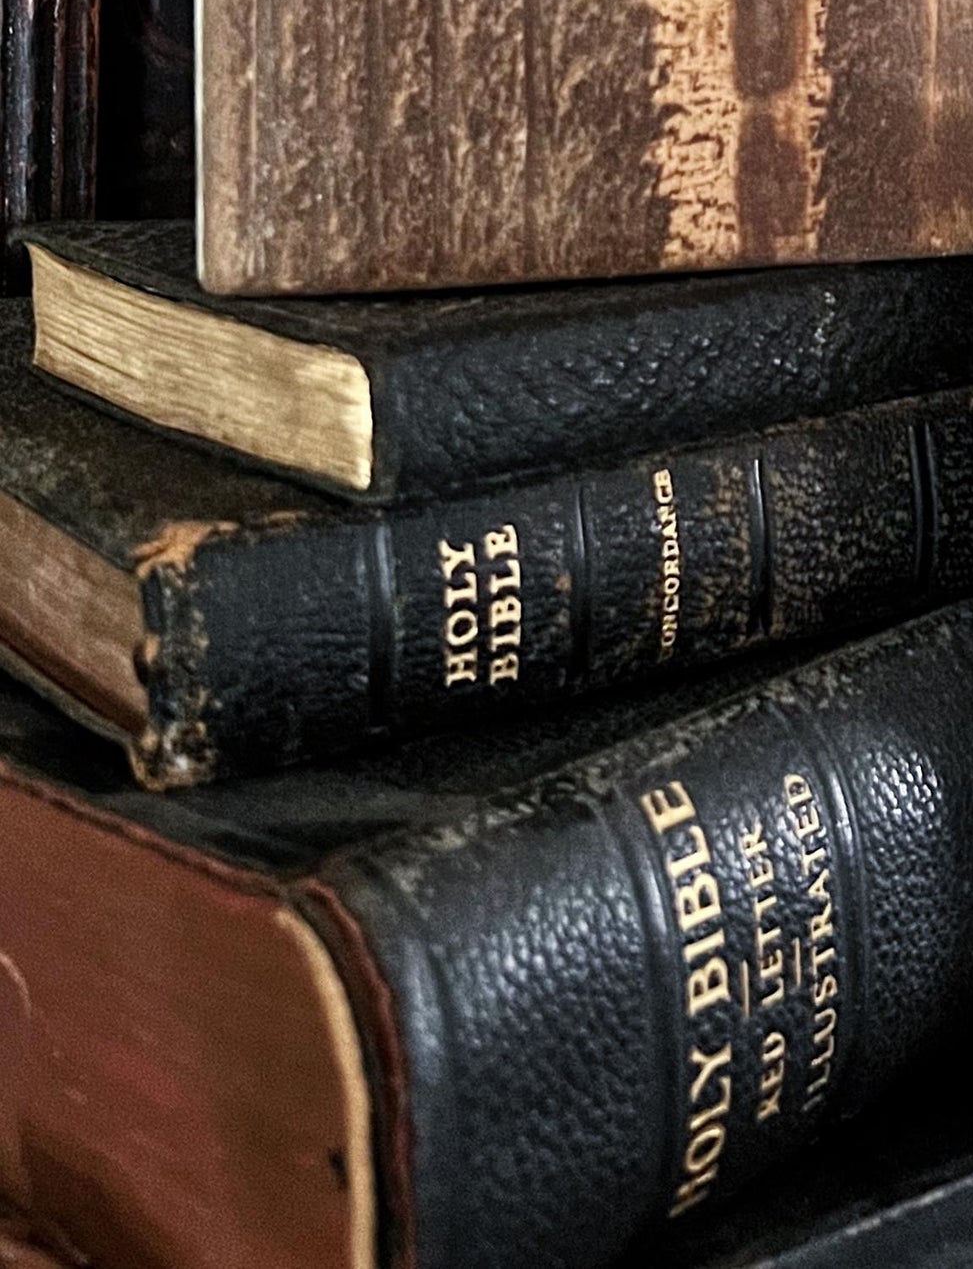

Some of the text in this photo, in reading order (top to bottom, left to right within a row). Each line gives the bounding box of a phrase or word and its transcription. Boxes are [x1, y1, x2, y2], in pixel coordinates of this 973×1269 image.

[438, 539, 478, 687] HOLY
[484, 524, 522, 686] BIBLE
[641, 781, 732, 1219] HOLY BIBLE
[738, 819, 786, 1123] RED LETTER
[783, 773, 838, 1112] ILLUSTRATED
